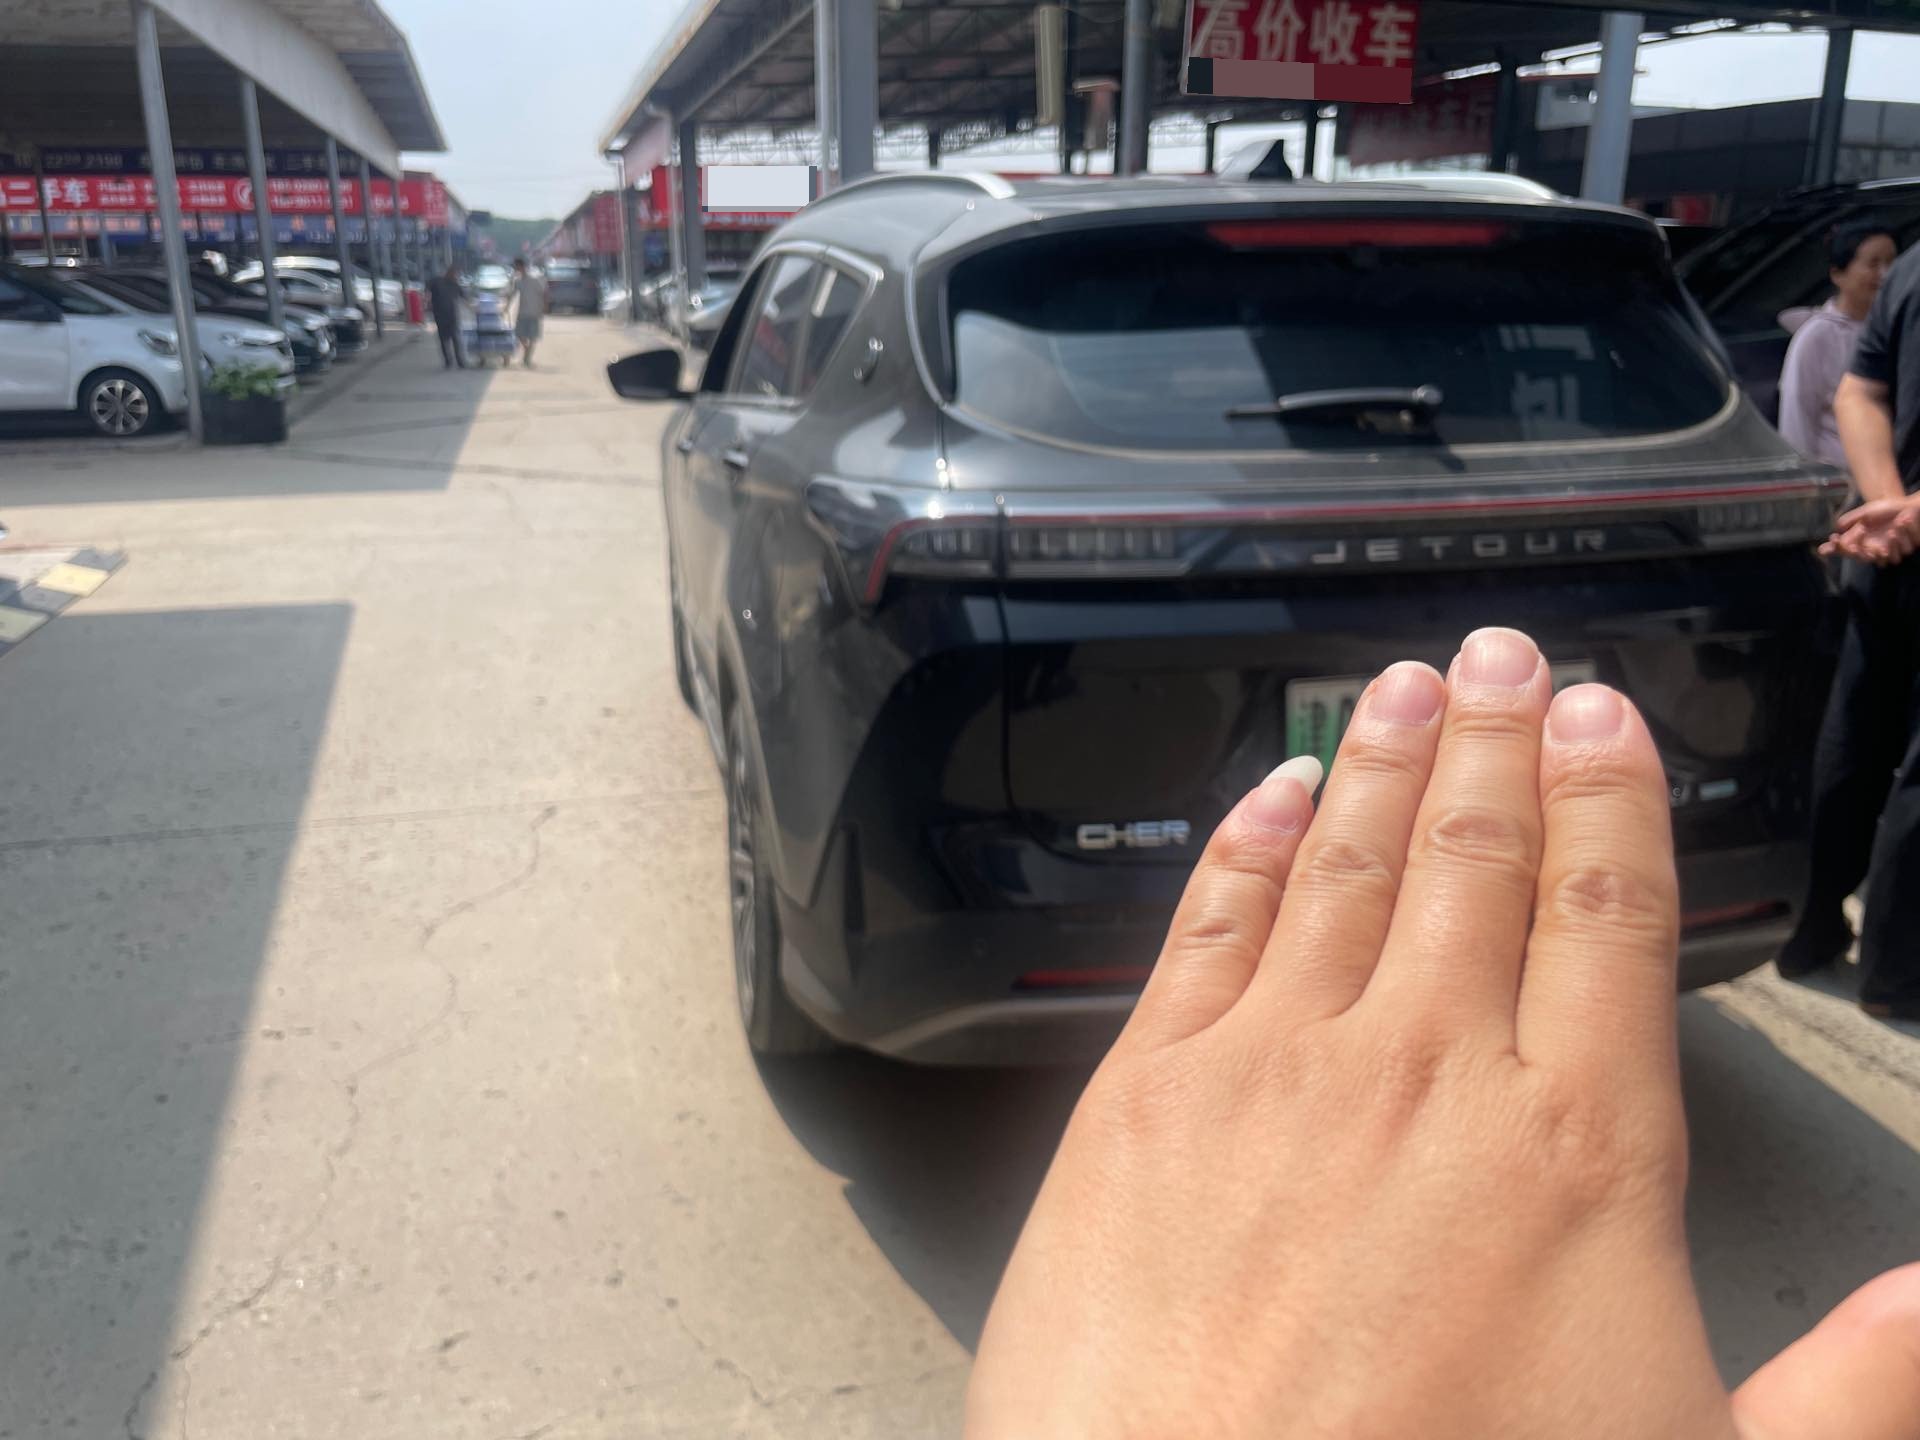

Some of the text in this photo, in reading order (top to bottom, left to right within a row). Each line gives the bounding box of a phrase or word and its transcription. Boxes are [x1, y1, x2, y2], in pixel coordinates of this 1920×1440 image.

[1198, 0, 1415, 67] 高价收车
[0, 177, 90, 208] 二手车
[1311, 530, 1607, 565] JETOUR
